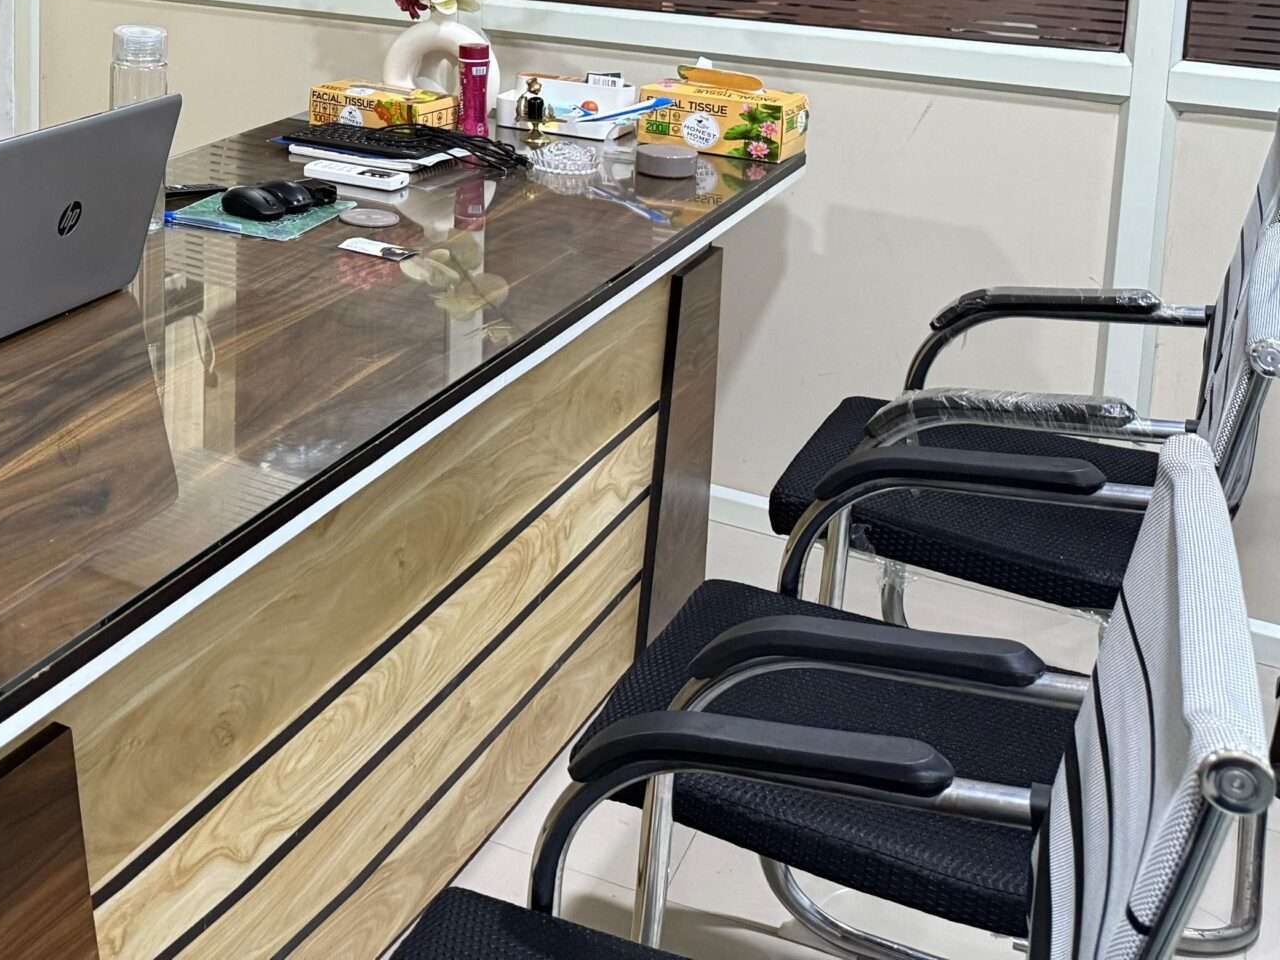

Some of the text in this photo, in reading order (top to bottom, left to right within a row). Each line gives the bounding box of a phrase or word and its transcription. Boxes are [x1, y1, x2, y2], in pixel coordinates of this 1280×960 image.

[312, 90, 375, 109] FACIAL TISSUE
[688, 101, 729, 115] TISSUE
[683, 124, 717, 139] HONEST
[686, 131, 711, 144] HOME
[58, 201, 82, 237] hp
